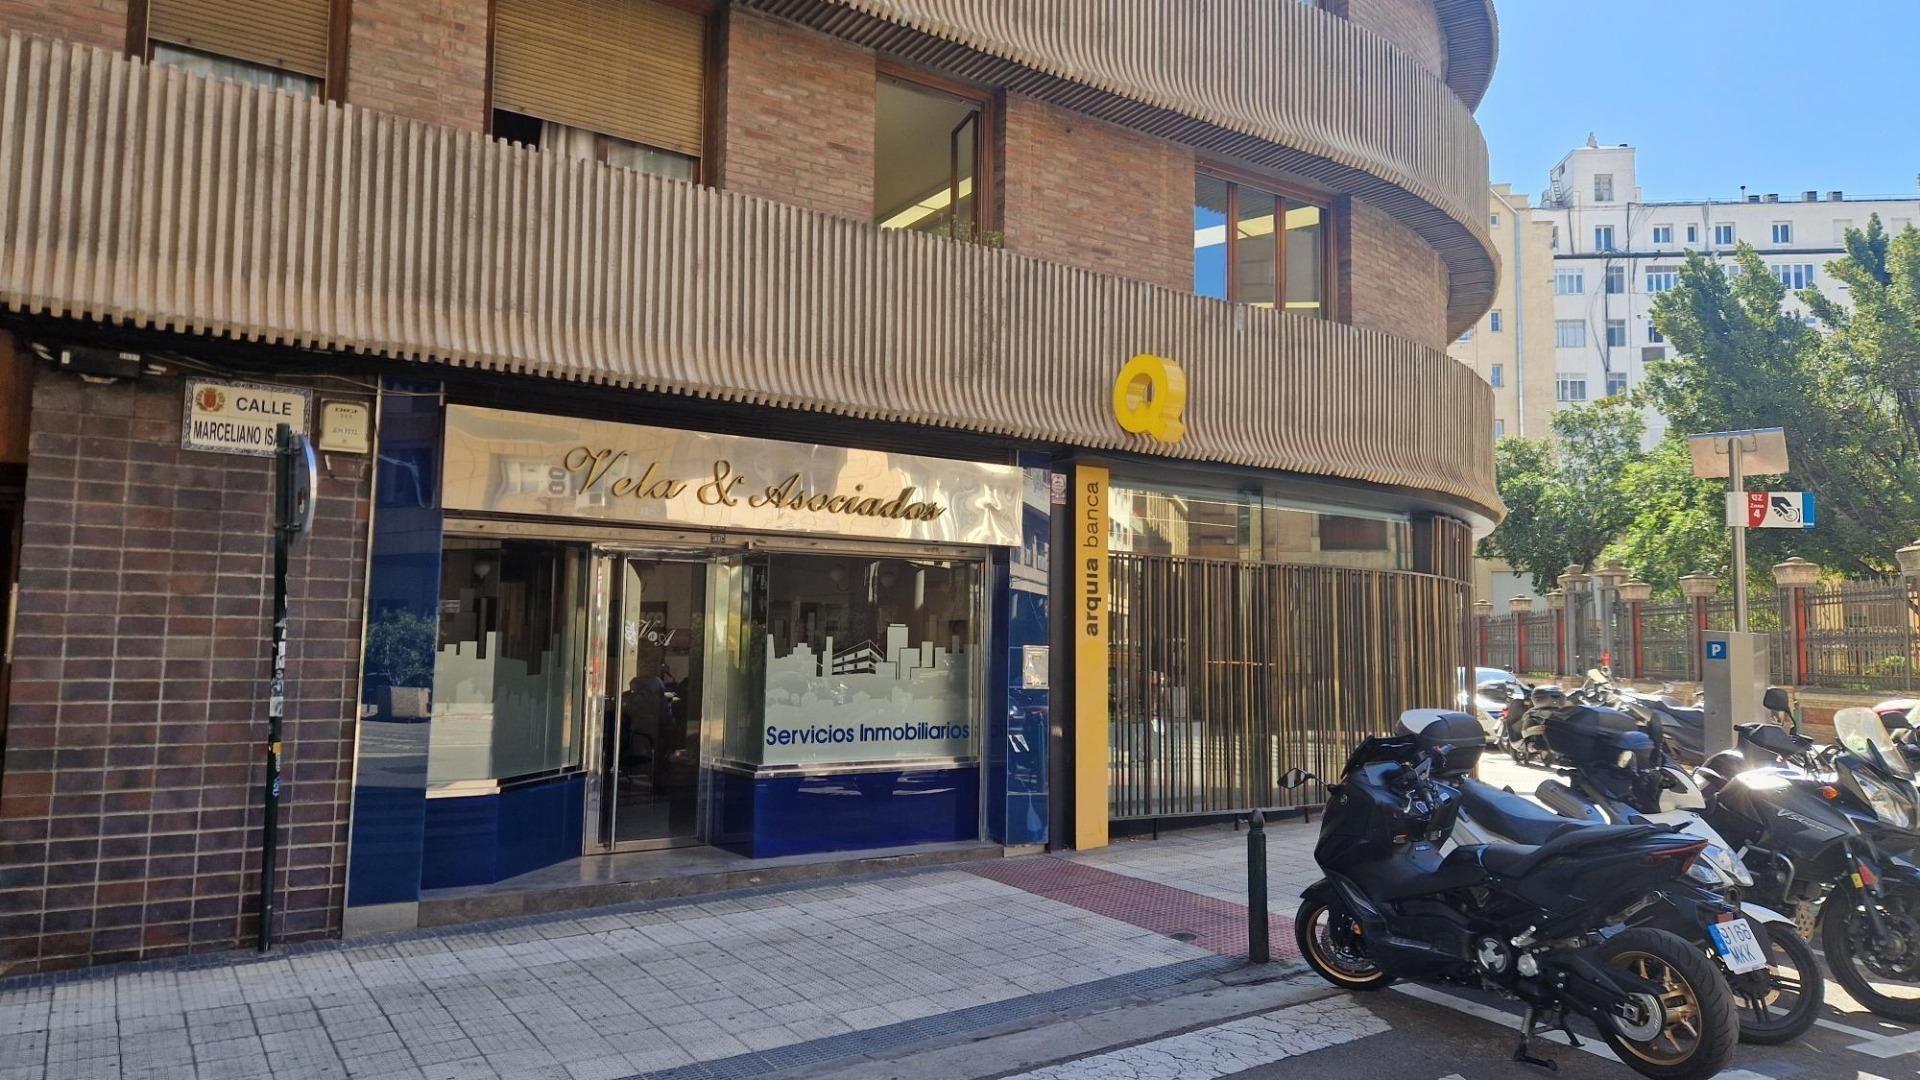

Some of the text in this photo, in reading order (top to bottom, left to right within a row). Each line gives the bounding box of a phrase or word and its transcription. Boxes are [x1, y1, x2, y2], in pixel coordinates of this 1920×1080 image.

[236, 397, 292, 417] CALLE
[1112, 352, 1186, 443] Q
[193, 420, 262, 445] MARCELIANO
[564, 446, 687, 499] Vela
[697, 459, 745, 507] &
[749, 472, 947, 521] Asociados
[1083, 481, 1101, 637] arquia banca
[1711, 643, 1721, 657] P
[765, 722, 970, 746] Servicios Inmobiliarios
